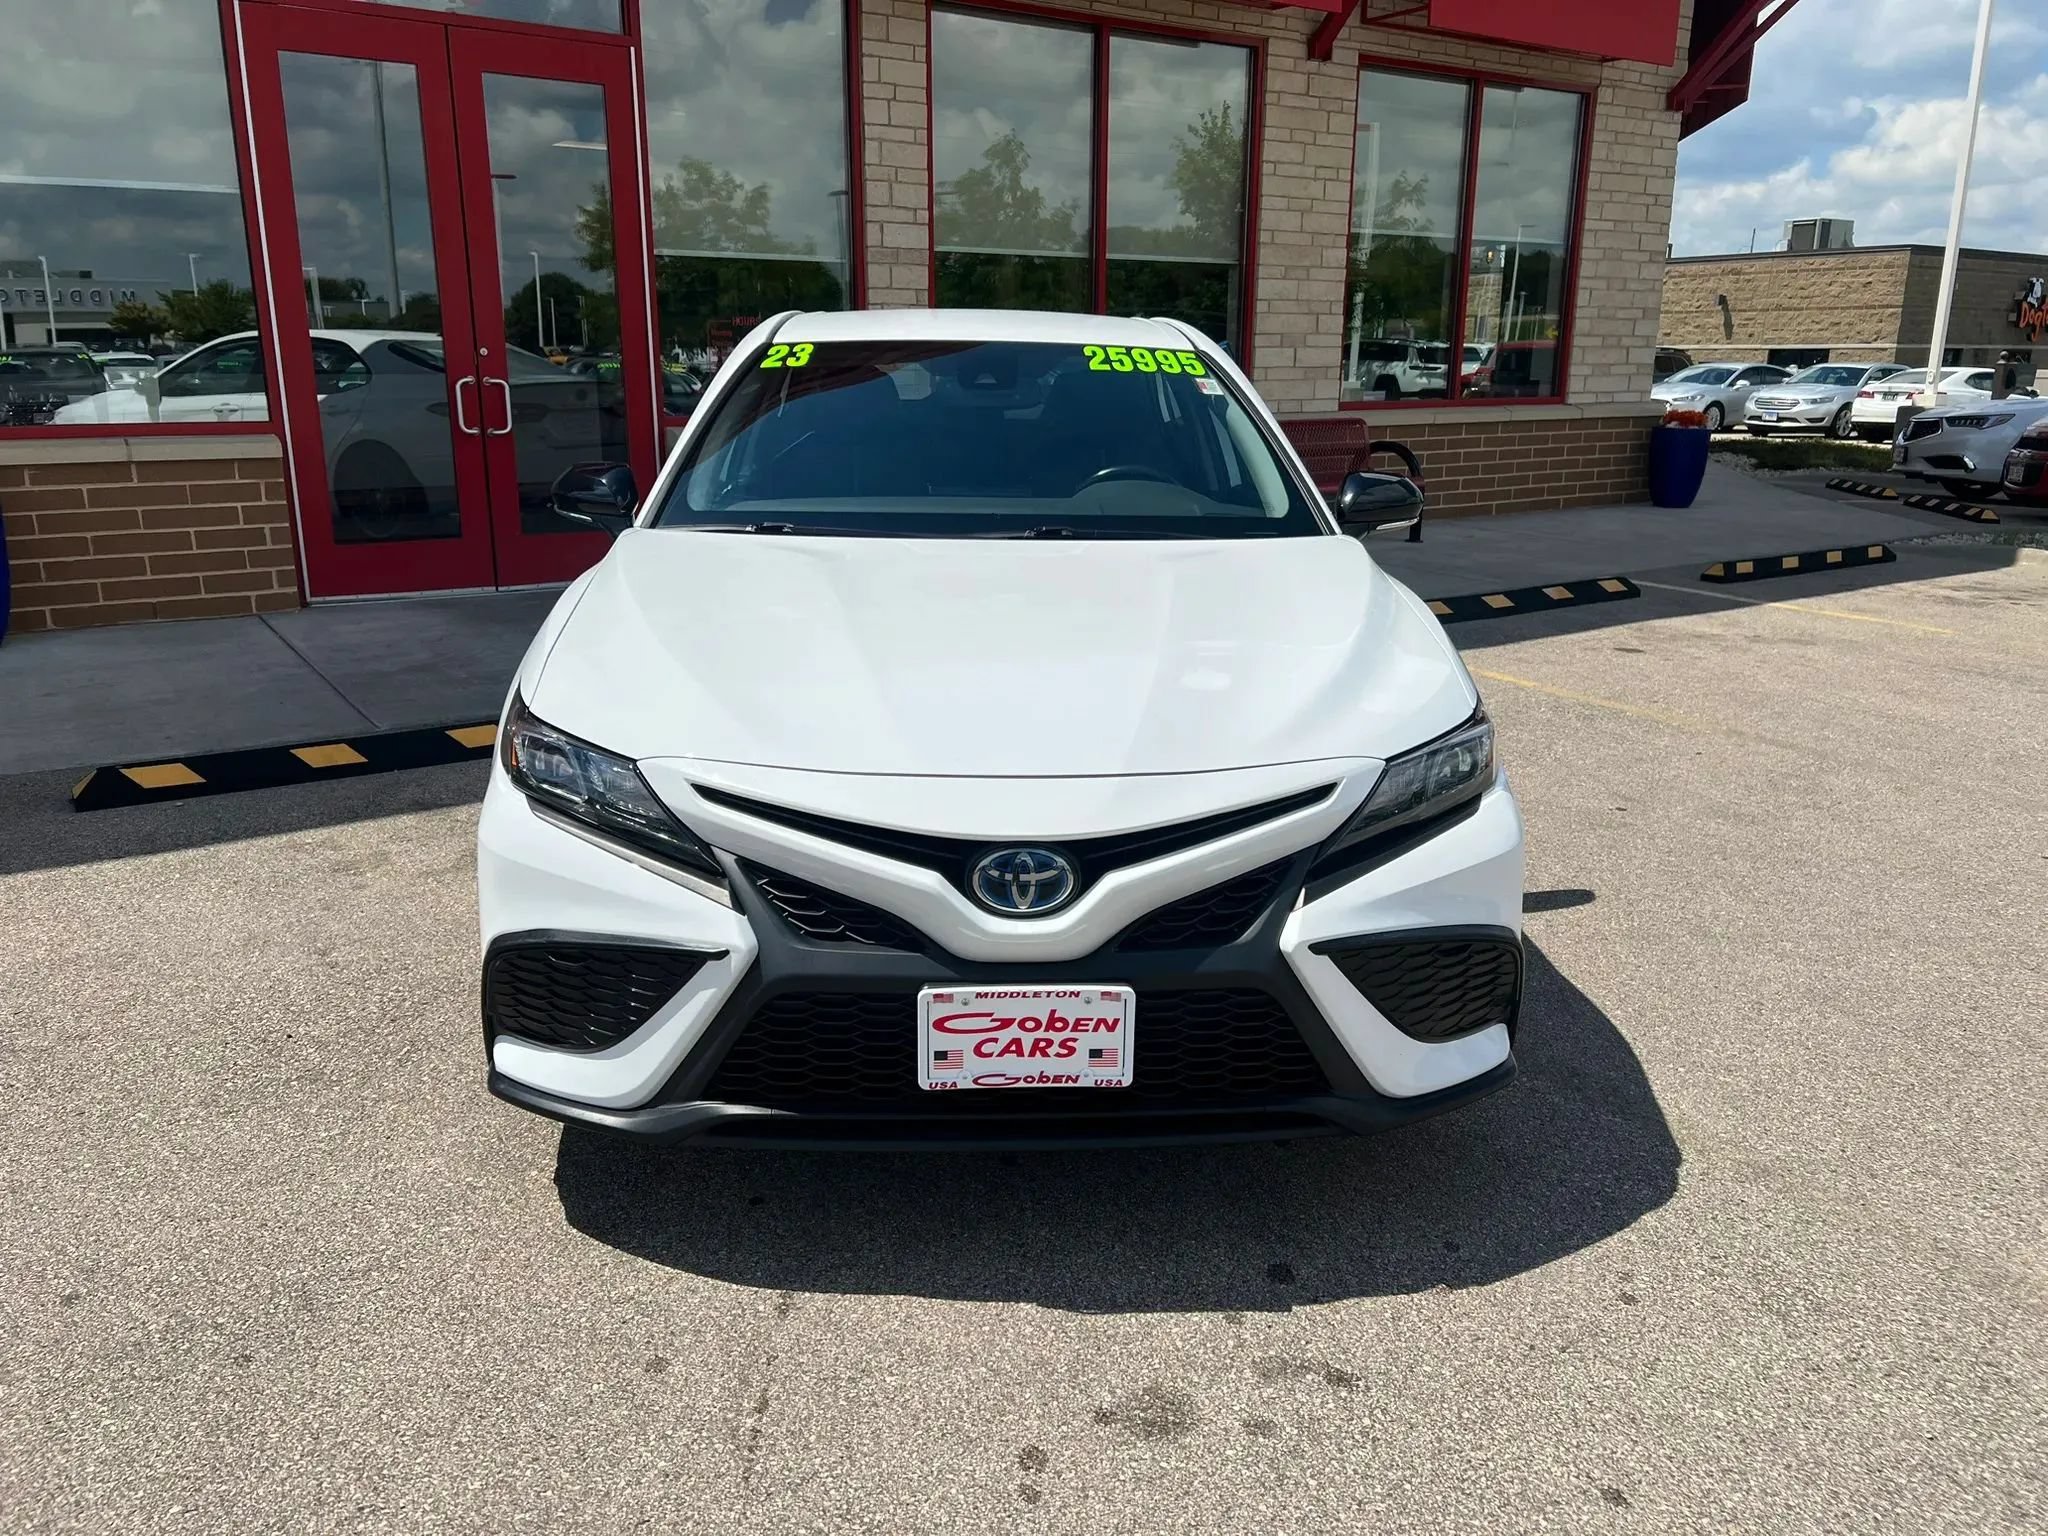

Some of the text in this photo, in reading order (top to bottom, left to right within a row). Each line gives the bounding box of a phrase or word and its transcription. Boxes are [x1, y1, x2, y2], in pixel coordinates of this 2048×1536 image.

[759, 343, 814, 368] 23
[1083, 345, 1206, 376] 25995
[974, 990, 1081, 999] MIDDLETON
[972, 1037, 1079, 1058] CARS
[1094, 1079, 1123, 1087] USA
